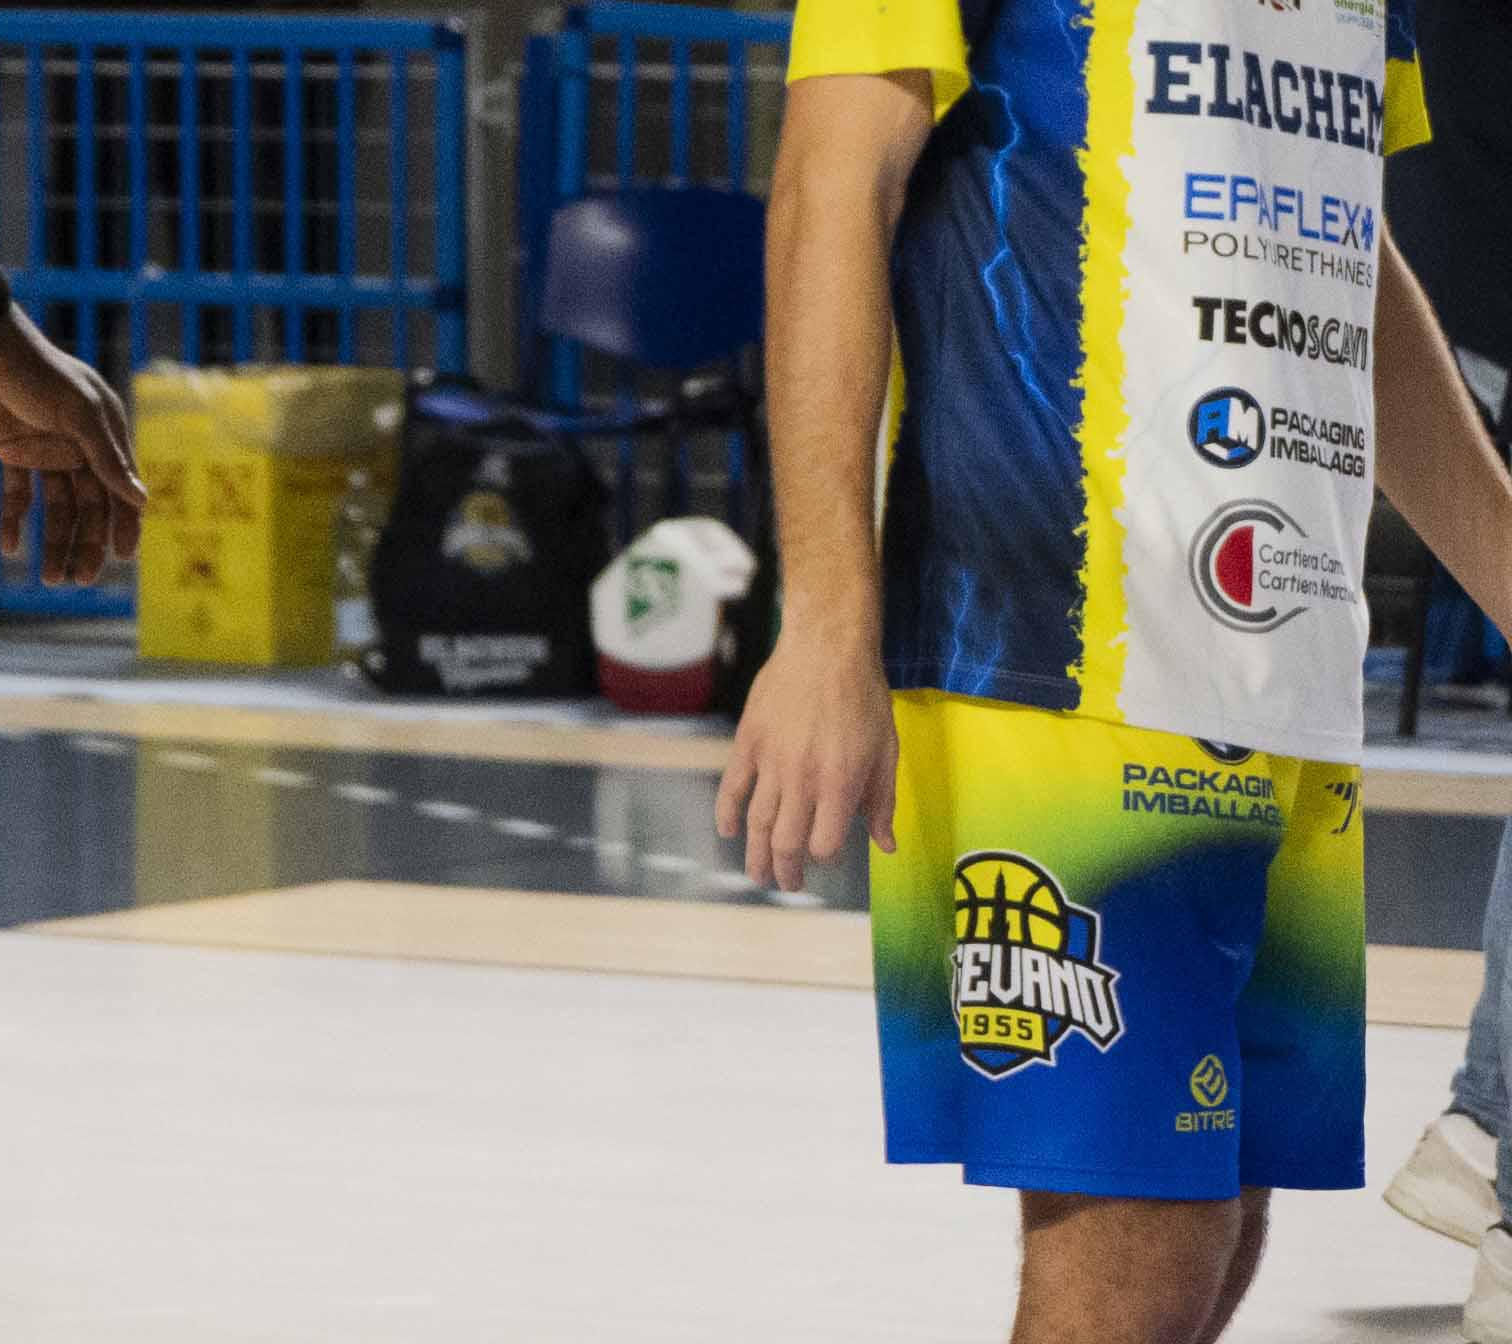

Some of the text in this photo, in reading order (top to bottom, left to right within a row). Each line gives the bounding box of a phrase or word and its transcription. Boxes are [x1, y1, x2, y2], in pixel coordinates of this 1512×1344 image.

[1183, 230, 1374, 289] POLYURETHANES
[1192, 295, 1368, 371] TECNOSCAVI
[1271, 408, 1364, 450] PACKAGING
[1259, 544, 1318, 570] Cartiera
[1259, 570, 1317, 596] Cartiera
[1123, 763, 1276, 799] PACKAGIN
[1122, 789, 1283, 827] IMBALLAG
[1175, 1109, 1235, 1132] BITRE
